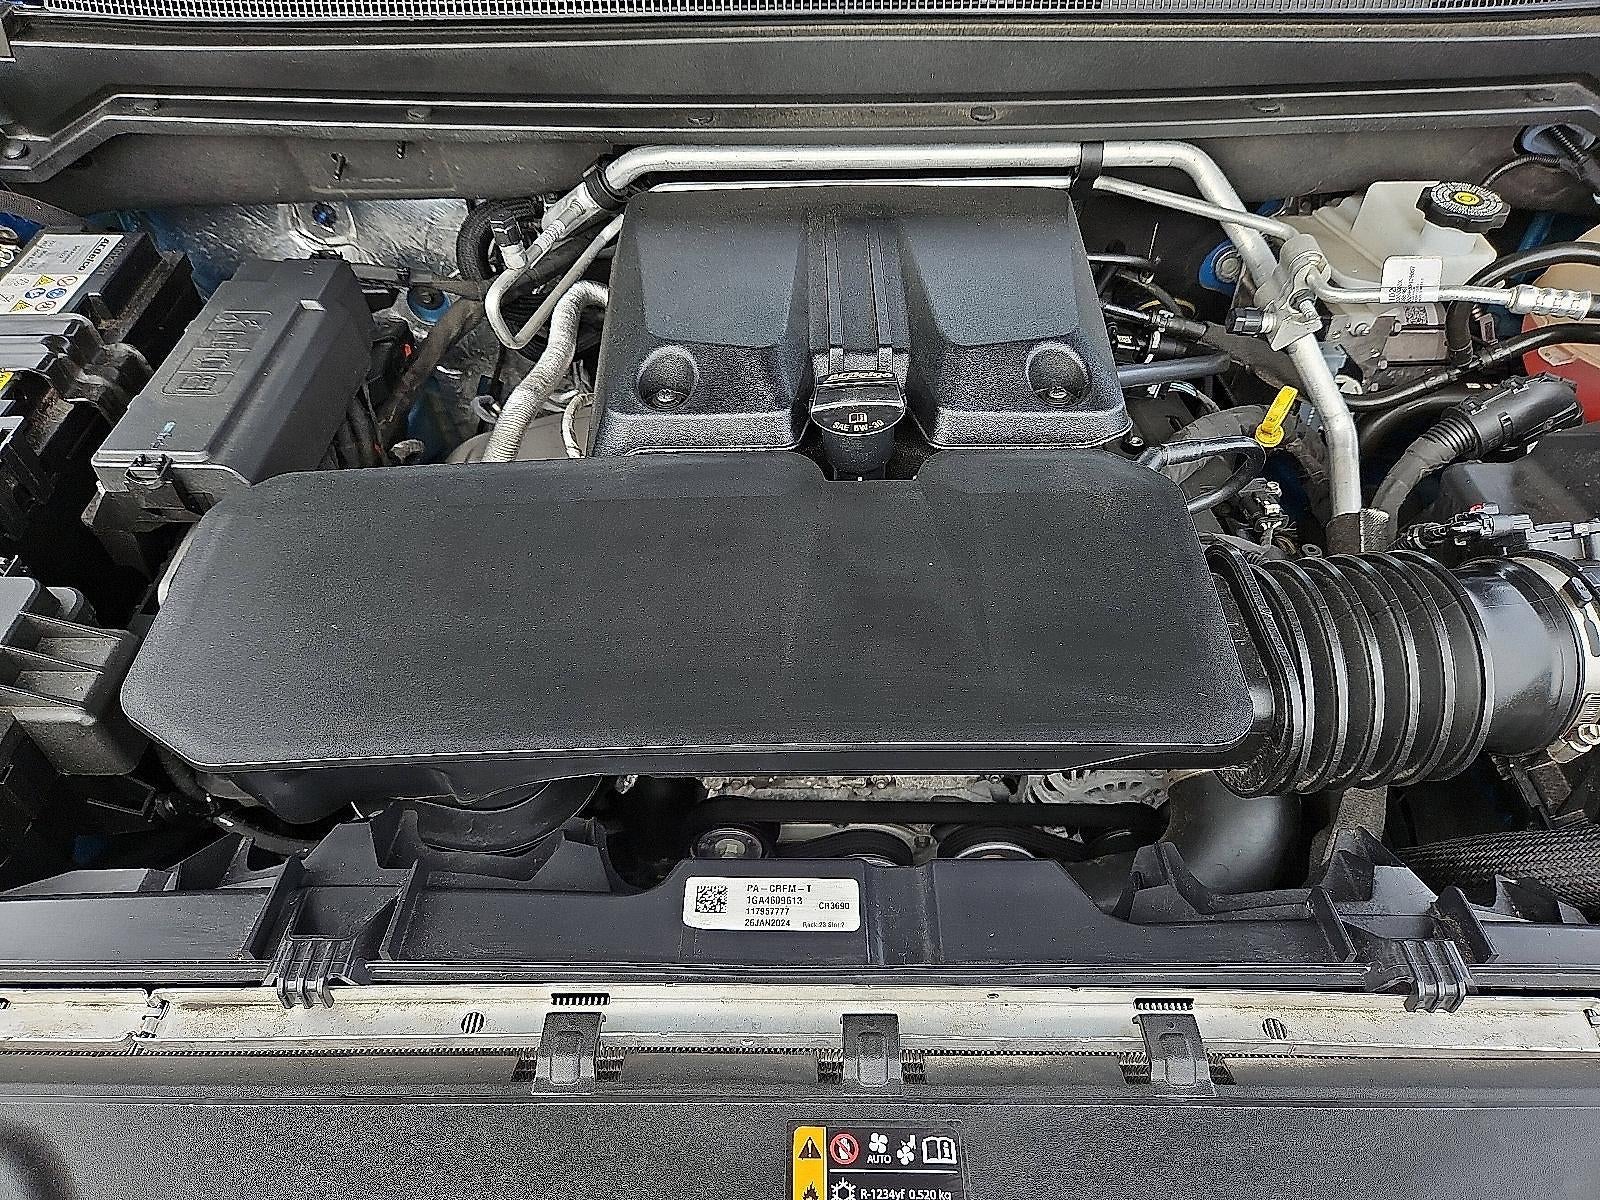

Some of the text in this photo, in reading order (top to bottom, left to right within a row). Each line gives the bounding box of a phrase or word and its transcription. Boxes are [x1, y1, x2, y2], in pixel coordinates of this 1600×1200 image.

[832, 421, 851, 432] SAE
[744, 918, 791, 927] 26JAN2024
[866, 1154, 892, 1164] AUTO
[860, 1188, 906, 1200] R-1234yf
[908, 1189, 937, 1200] 0.520
